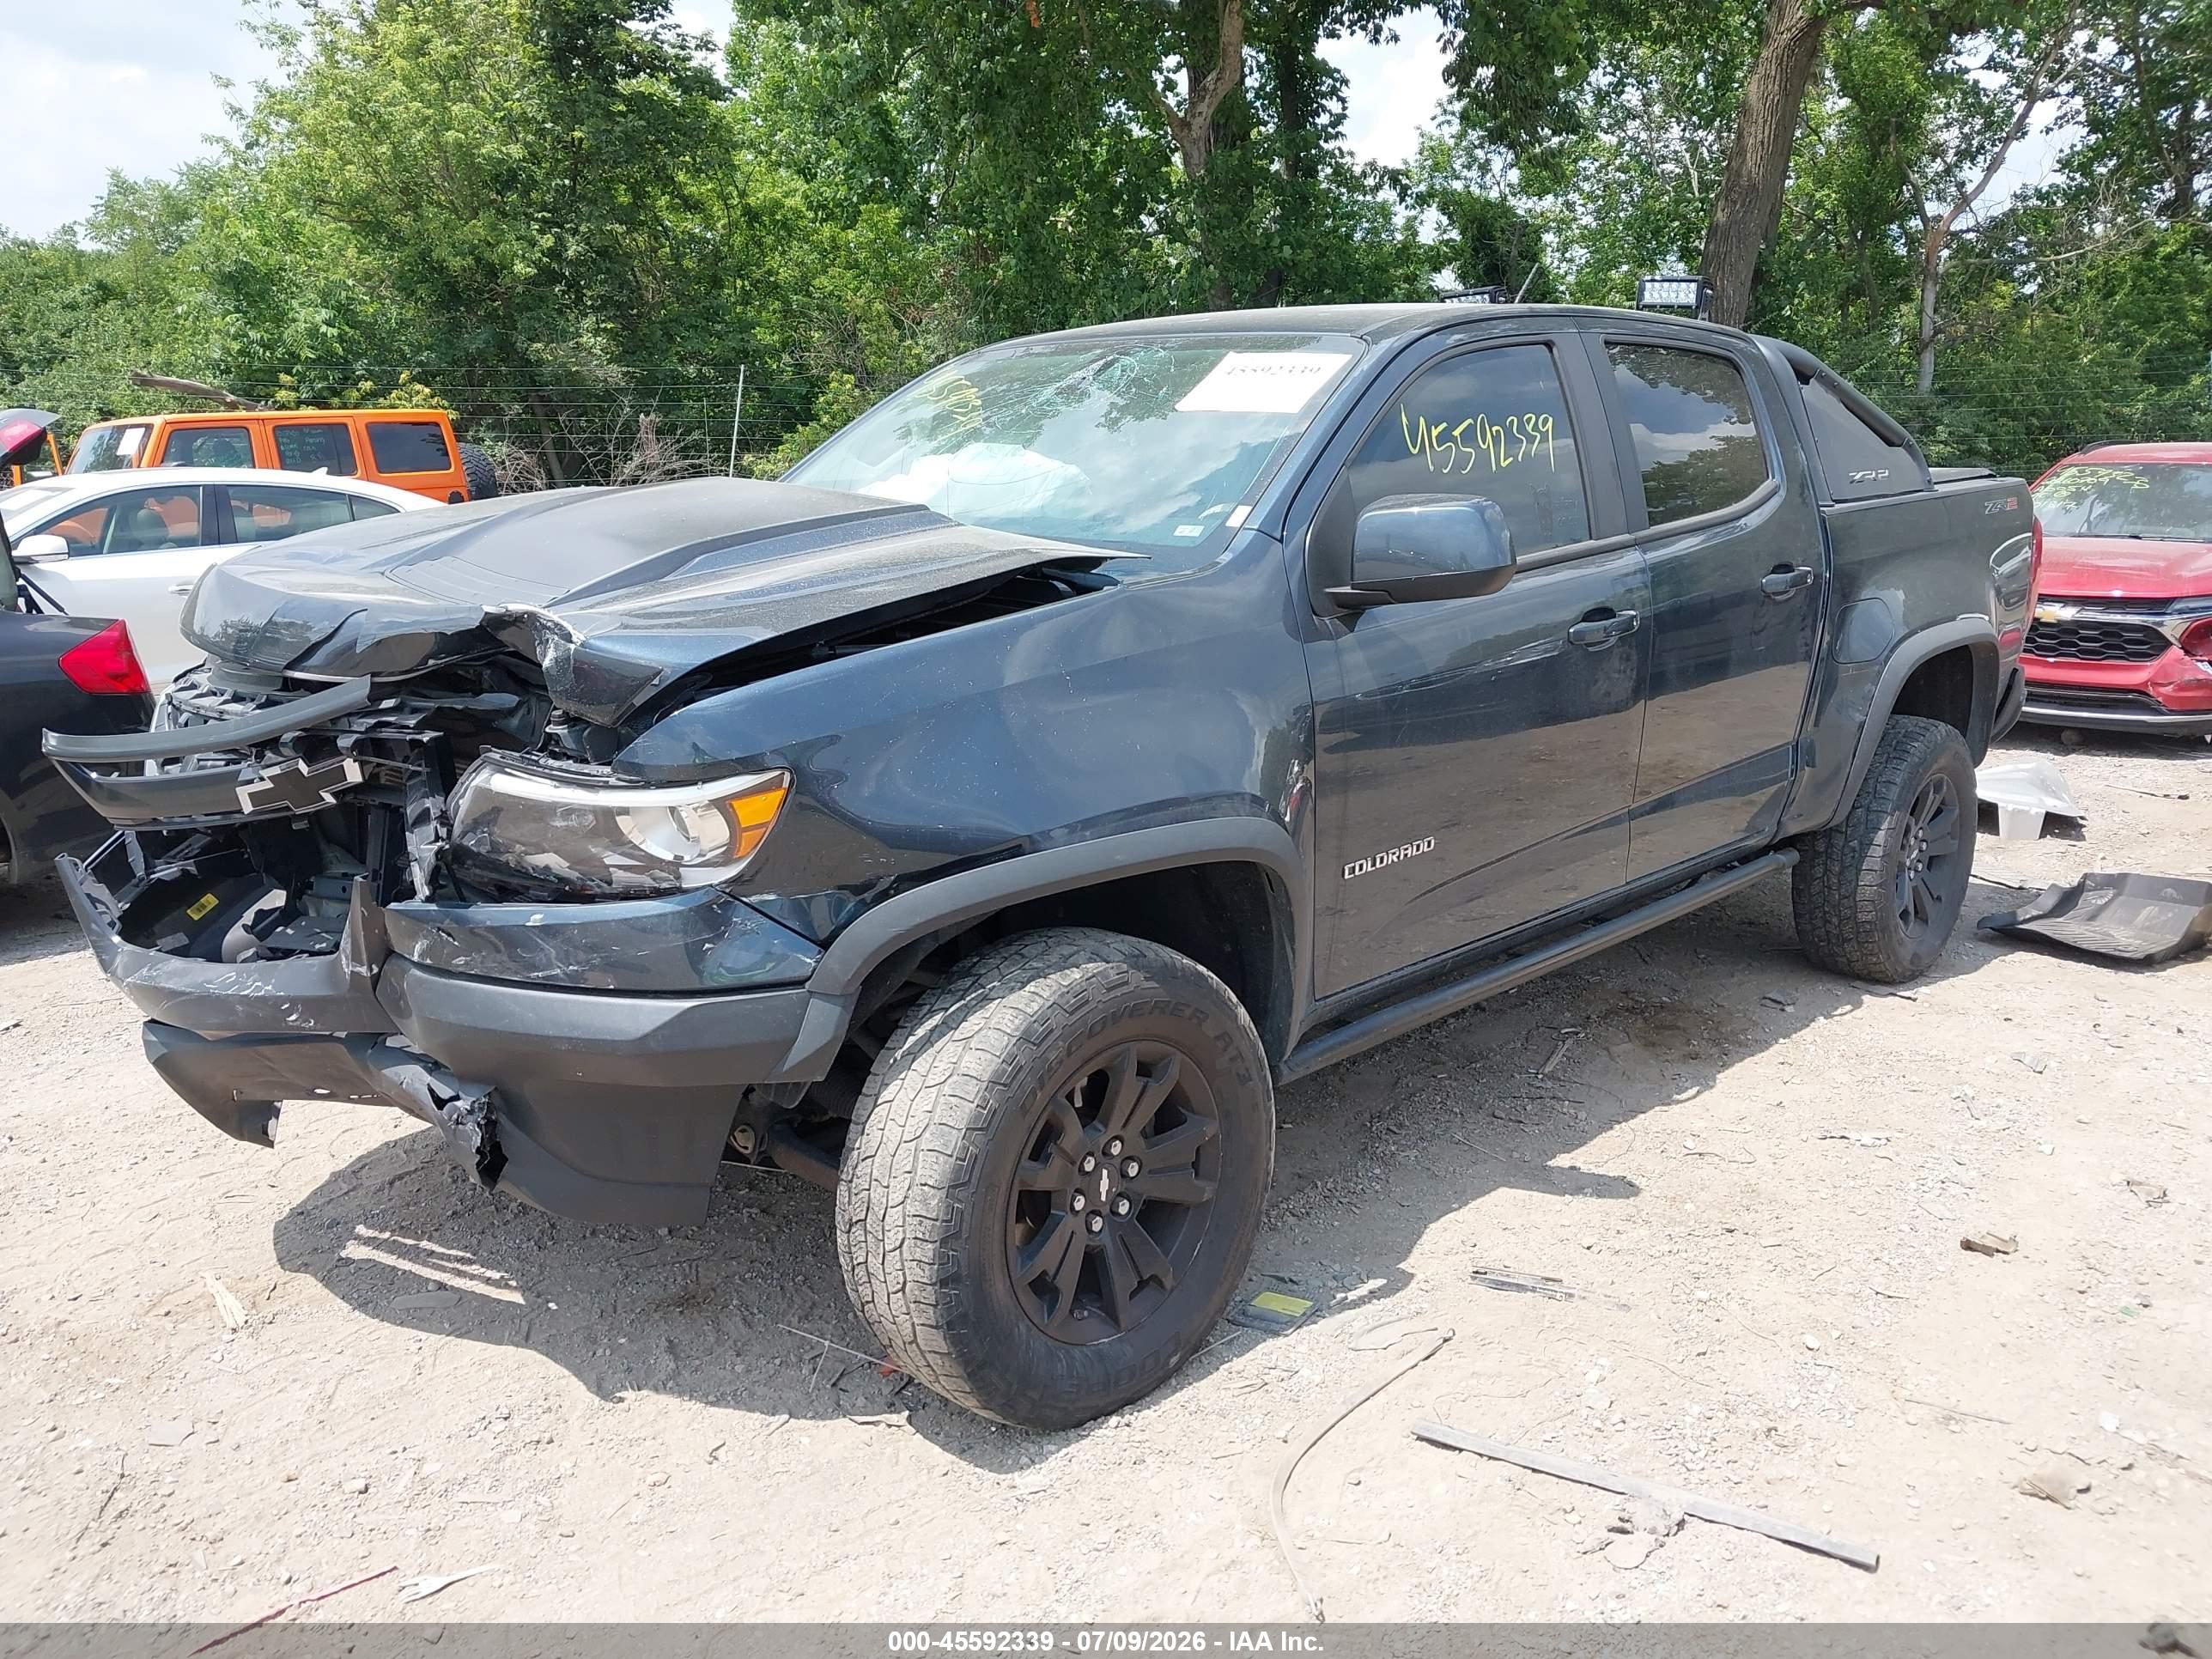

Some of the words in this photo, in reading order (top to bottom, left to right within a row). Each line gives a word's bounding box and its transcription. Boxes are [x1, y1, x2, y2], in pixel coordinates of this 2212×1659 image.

[1401, 403, 1555, 474] 45592339
[1984, 496, 2018, 515] ZR2
[1343, 836, 1436, 880] COLORADO
